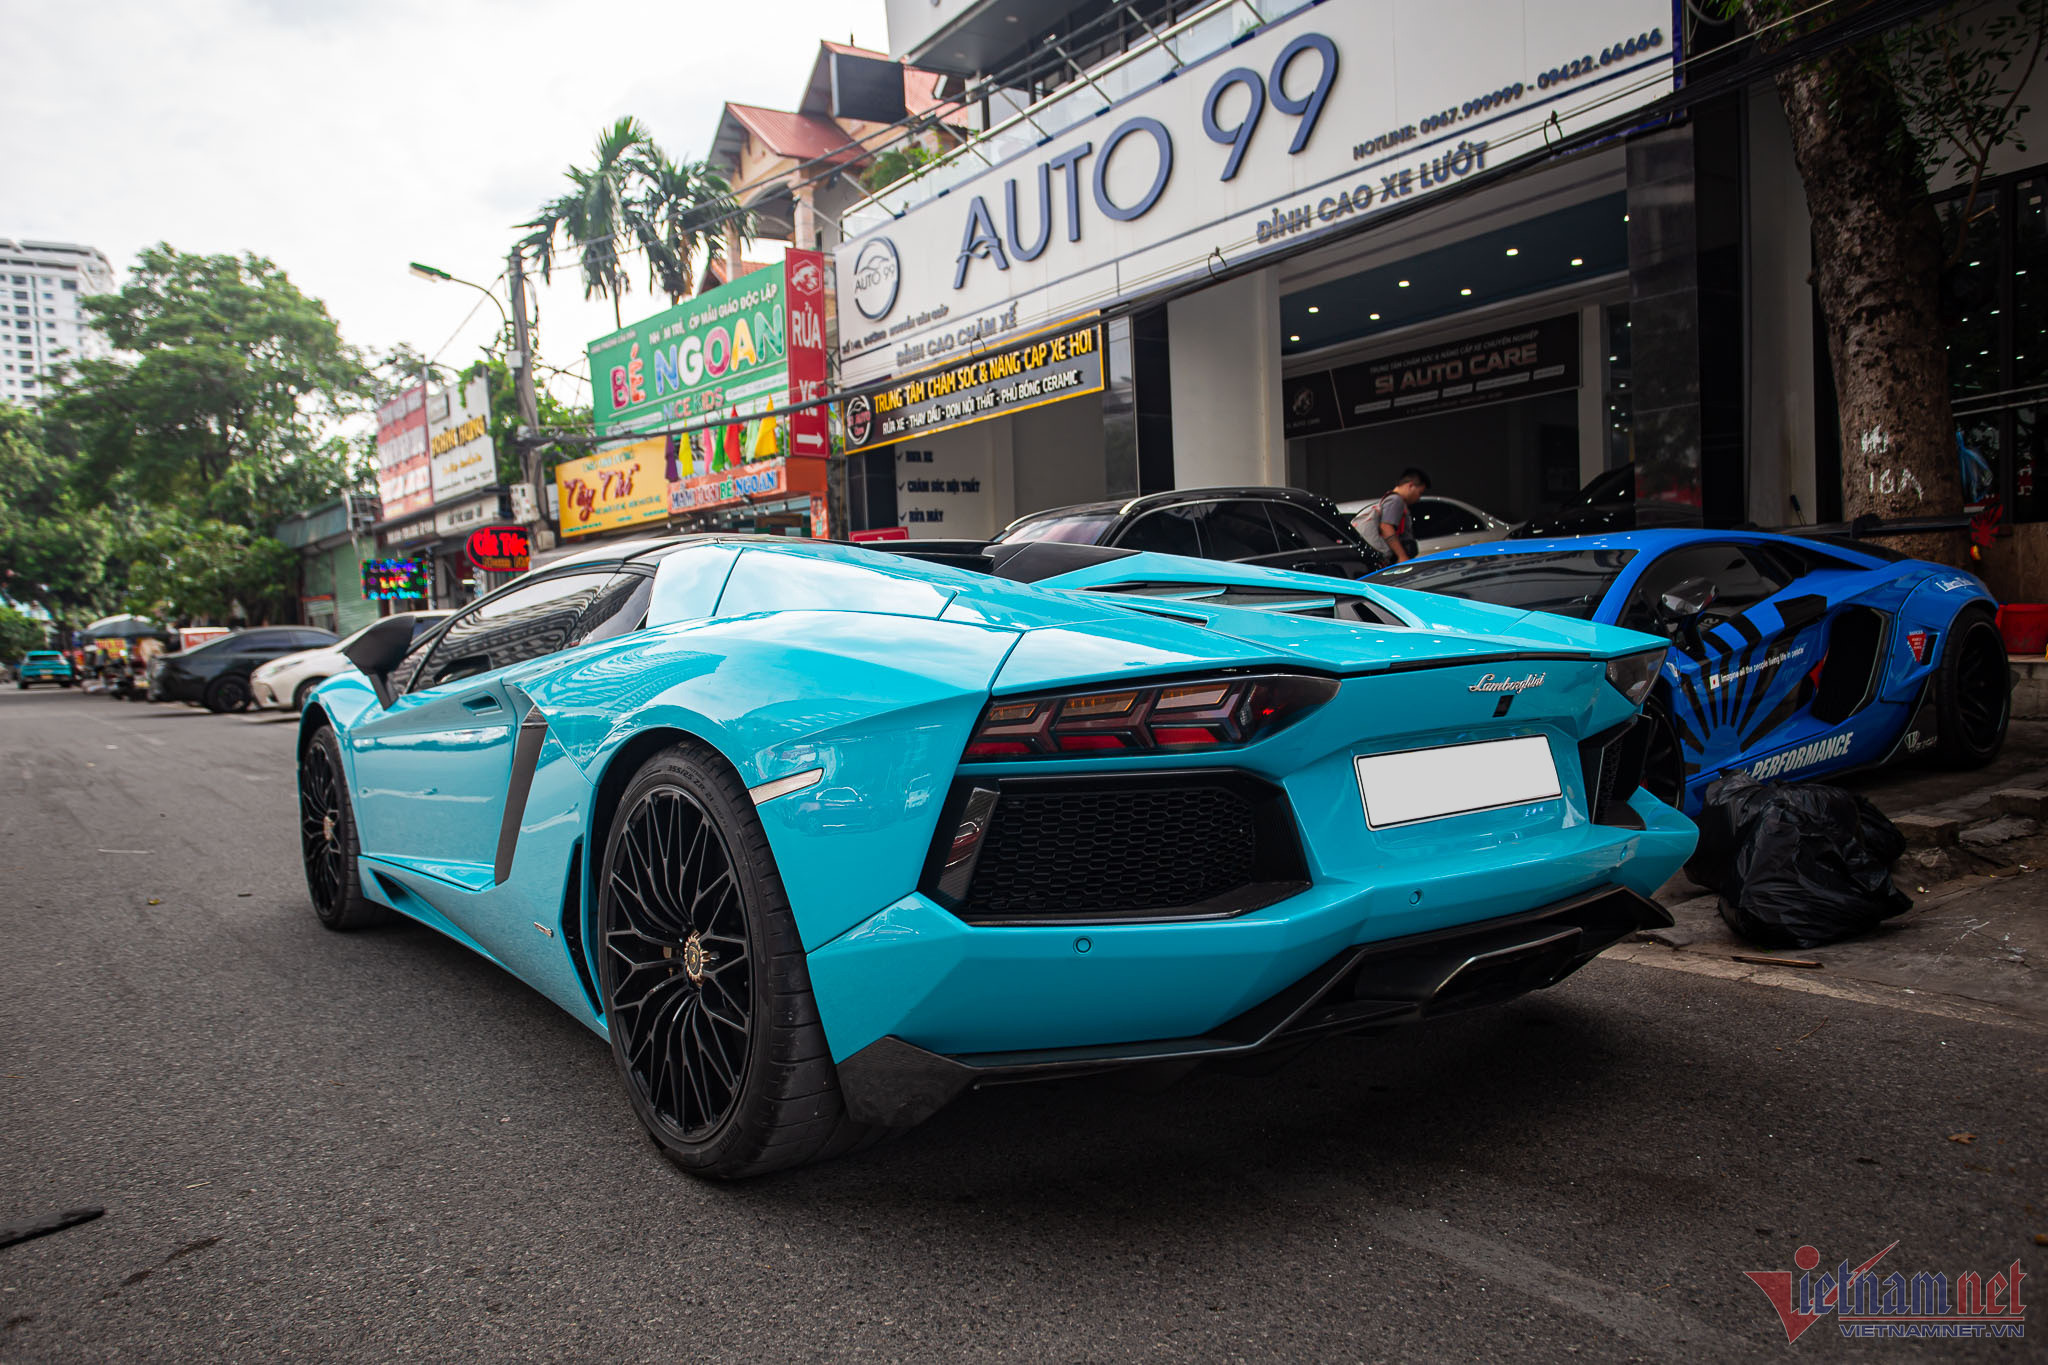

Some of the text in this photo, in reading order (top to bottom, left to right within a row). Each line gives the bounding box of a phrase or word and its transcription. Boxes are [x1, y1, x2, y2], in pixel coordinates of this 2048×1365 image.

[1353, 125, 1417, 160] HOTLINE:
[1420, 82, 1524, 134] 0967.999999
[1537, 28, 1664, 89] 09422.66666
[953, 32, 1339, 289] AUTO 99
[1317, 183, 1374, 222] CAO
[1380, 168, 1413, 203] XE
[855, 263, 897, 293] AUTO 99
[791, 301, 823, 350] RỬA
[927, 333, 955, 356] CAO
[609, 303, 786, 410] BÉ NGOAN
[873, 388, 903, 414] TRUNG
[978, 361, 988, 383] &
[1050, 335, 1067, 363] XE
[1400, 359, 1463, 391] AUTO
[1469, 343, 1538, 376] CARE
[896, 416, 905, 431] XE
[909, 411, 926, 429] THAY
[1001, 383, 1018, 404] PHỦ
[1018, 379, 1041, 399] BÓNG
[1042, 369, 1078, 392] CERAMIC
[719, 475, 735, 500] BÉ
[735, 470, 778, 496] NGOAN
[1468, 672, 1547, 694] Lamborghini
[1720, 669, 1739, 683] Imagine
[1745, 665, 1753, 674] the
[1753, 660, 1768, 674] people
[1768, 655, 1780, 668] living
[1750, 731, 1854, 781] PERFORMANCE
